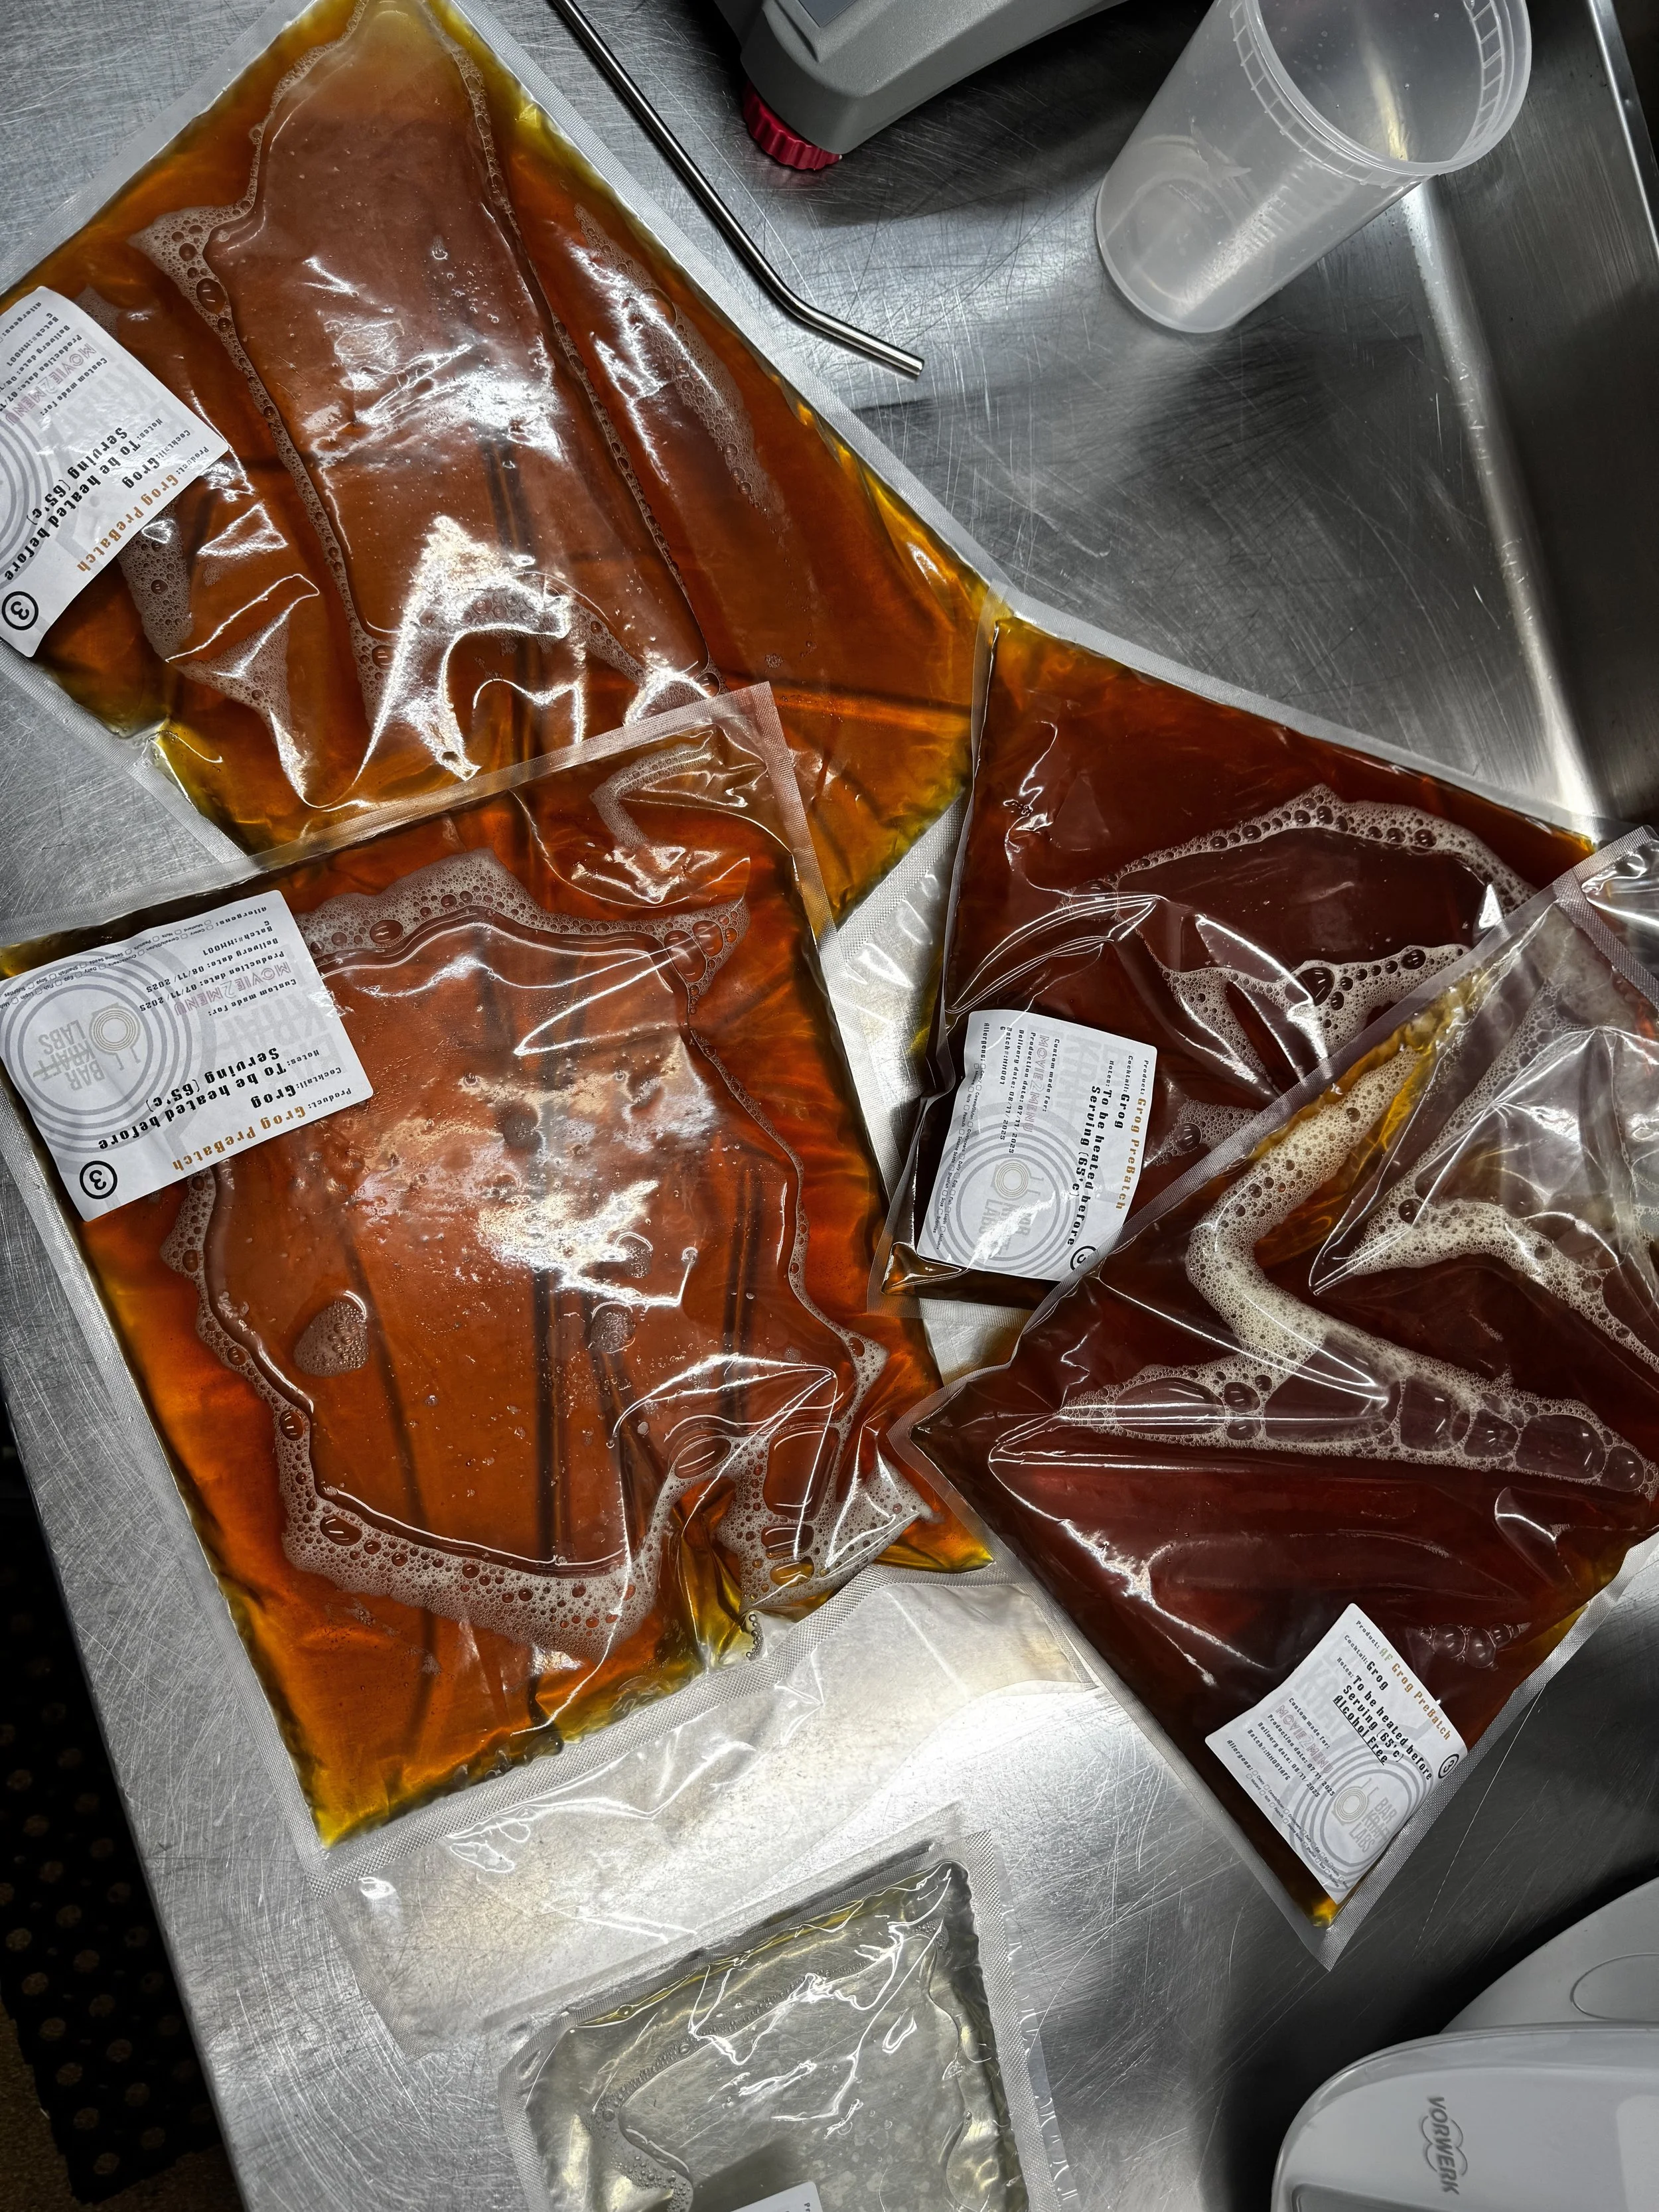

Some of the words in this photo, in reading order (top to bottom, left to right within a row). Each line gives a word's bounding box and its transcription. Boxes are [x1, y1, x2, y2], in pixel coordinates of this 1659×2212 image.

[0, 302, 42, 336] Allergens:
[36, 325, 70, 354] Delivery
[38, 334, 82, 372] Production
[16, 354, 36, 375] date:
[77, 357, 108, 382] Custom
[0, 374, 18, 394] 08/1
[17, 372, 38, 391] date:
[56, 382, 78, 401] made
[40, 401, 58, 416] for:
[137, 417, 163, 440] Notes:
[67, 427, 127, 479] Serving
[119, 440, 141, 455] To
[155, 429, 190, 459] Cocktail:
[100, 456, 121, 475] be
[121, 457, 160, 488] Grog
[175, 446, 209, 475] Product:
[47, 475, 101, 528] heated
[140, 474, 179, 506] Grog
[76, 506, 144, 571] PreBatch
[2, 527, 50, 581] before
[216, 907, 267, 926] Allergens:
[206, 954, 233, 968] date:
[229, 950, 285, 974] Production
[236, 938, 279, 957] Delivery
[146, 978, 171, 993] 2025
[199, 972, 226, 986] date:
[259, 979, 297, 995] Custom
[139, 996, 164, 1011] 2025
[208, 1005, 228, 1016] for:
[231, 994, 257, 1007] made
[36, 1018, 87, 1057] LABS
[980, 1023, 990, 1061] Allergens:
[1013, 1029, 1025, 1064] Delivery
[204, 1047, 279, 1084] Serving
[287, 1049, 320, 1066] Notes:
[1024, 1032, 1036, 1078] Production
[1050, 1039, 1060, 1069] Custom
[64, 1058, 106, 1093] BAR
[235, 1072, 259, 1088] be
[263, 1063, 287, 1076] To
[296, 1067, 342, 1088] Cocktail:
[1011, 1067, 1019, 1088] date:
[1106, 1060, 1114, 1087] Notes:
[1123, 1055, 1133, 1092] Cocktail:
[1140, 1060, 1149, 1094] Product:
[164, 1084, 230, 1122] heated
[250, 1084, 296, 1108] Grog
[307, 1088, 352, 1108] Product:
[1019, 1080, 1028, 1102] date:
[1042, 1096, 1050, 1112] for:
[1102, 1090, 1112, 1106] To
[260, 1106, 306, 1130] Grog
[1080, 1086, 1101, 1146] Serving
[1097, 1112, 1109, 1129] be
[1114, 1094, 1130, 1128] Grog
[1131, 1098, 1146, 1133] Grog
[98, 1116, 161, 1149] before
[999, 1120, 1009, 1140] 2025
[1009, 1133, 1017, 1153] 2025
[172, 1126, 256, 1171] PreBatch
[1084, 1135, 1105, 1189] heated
[1116, 1139, 1139, 1209] PreBatch
[1067, 1195, 1091, 1245] before
[1344, 1635, 1368, 1664] Cocktail:
[1366, 1660, 1388, 1690] Grog
[1356, 1620, 1380, 1649] Product:
[1379, 1648, 1393, 1661] AF
[1392, 1662, 1413, 1693] Grog
[1413, 1690, 1451, 1740] PreBatch
[1336, 1657, 1354, 1678] Notes:
[1352, 1674, 1364, 1691] To
[1364, 1690, 1376, 1707] be
[1376, 1706, 1409, 1747] heated
[1406, 1744, 1432, 1780] before
[1342, 1684, 1378, 1731] Serving
[1289, 1698, 1307, 1721] Custom
[1306, 1720, 1320, 1737] made
[1319, 1735, 1330, 1749] for:
[1332, 1693, 1372, 1739] Alcohol
[1365, 1735, 1390, 1765] Free
[1226, 1739, 1253, 1771] Allergens:
[1258, 1722, 1279, 1748] Delivery
[1277, 1747, 1292, 1764] date:
[1306, 1782, 1320, 1797] 2025
[1267, 1714, 1294, 1747] Production
[1293, 1747, 1308, 1763] date:
[1321, 1781, 1335, 1797] 2025
[1428, 2097, 1459, 2195] VORWERK
